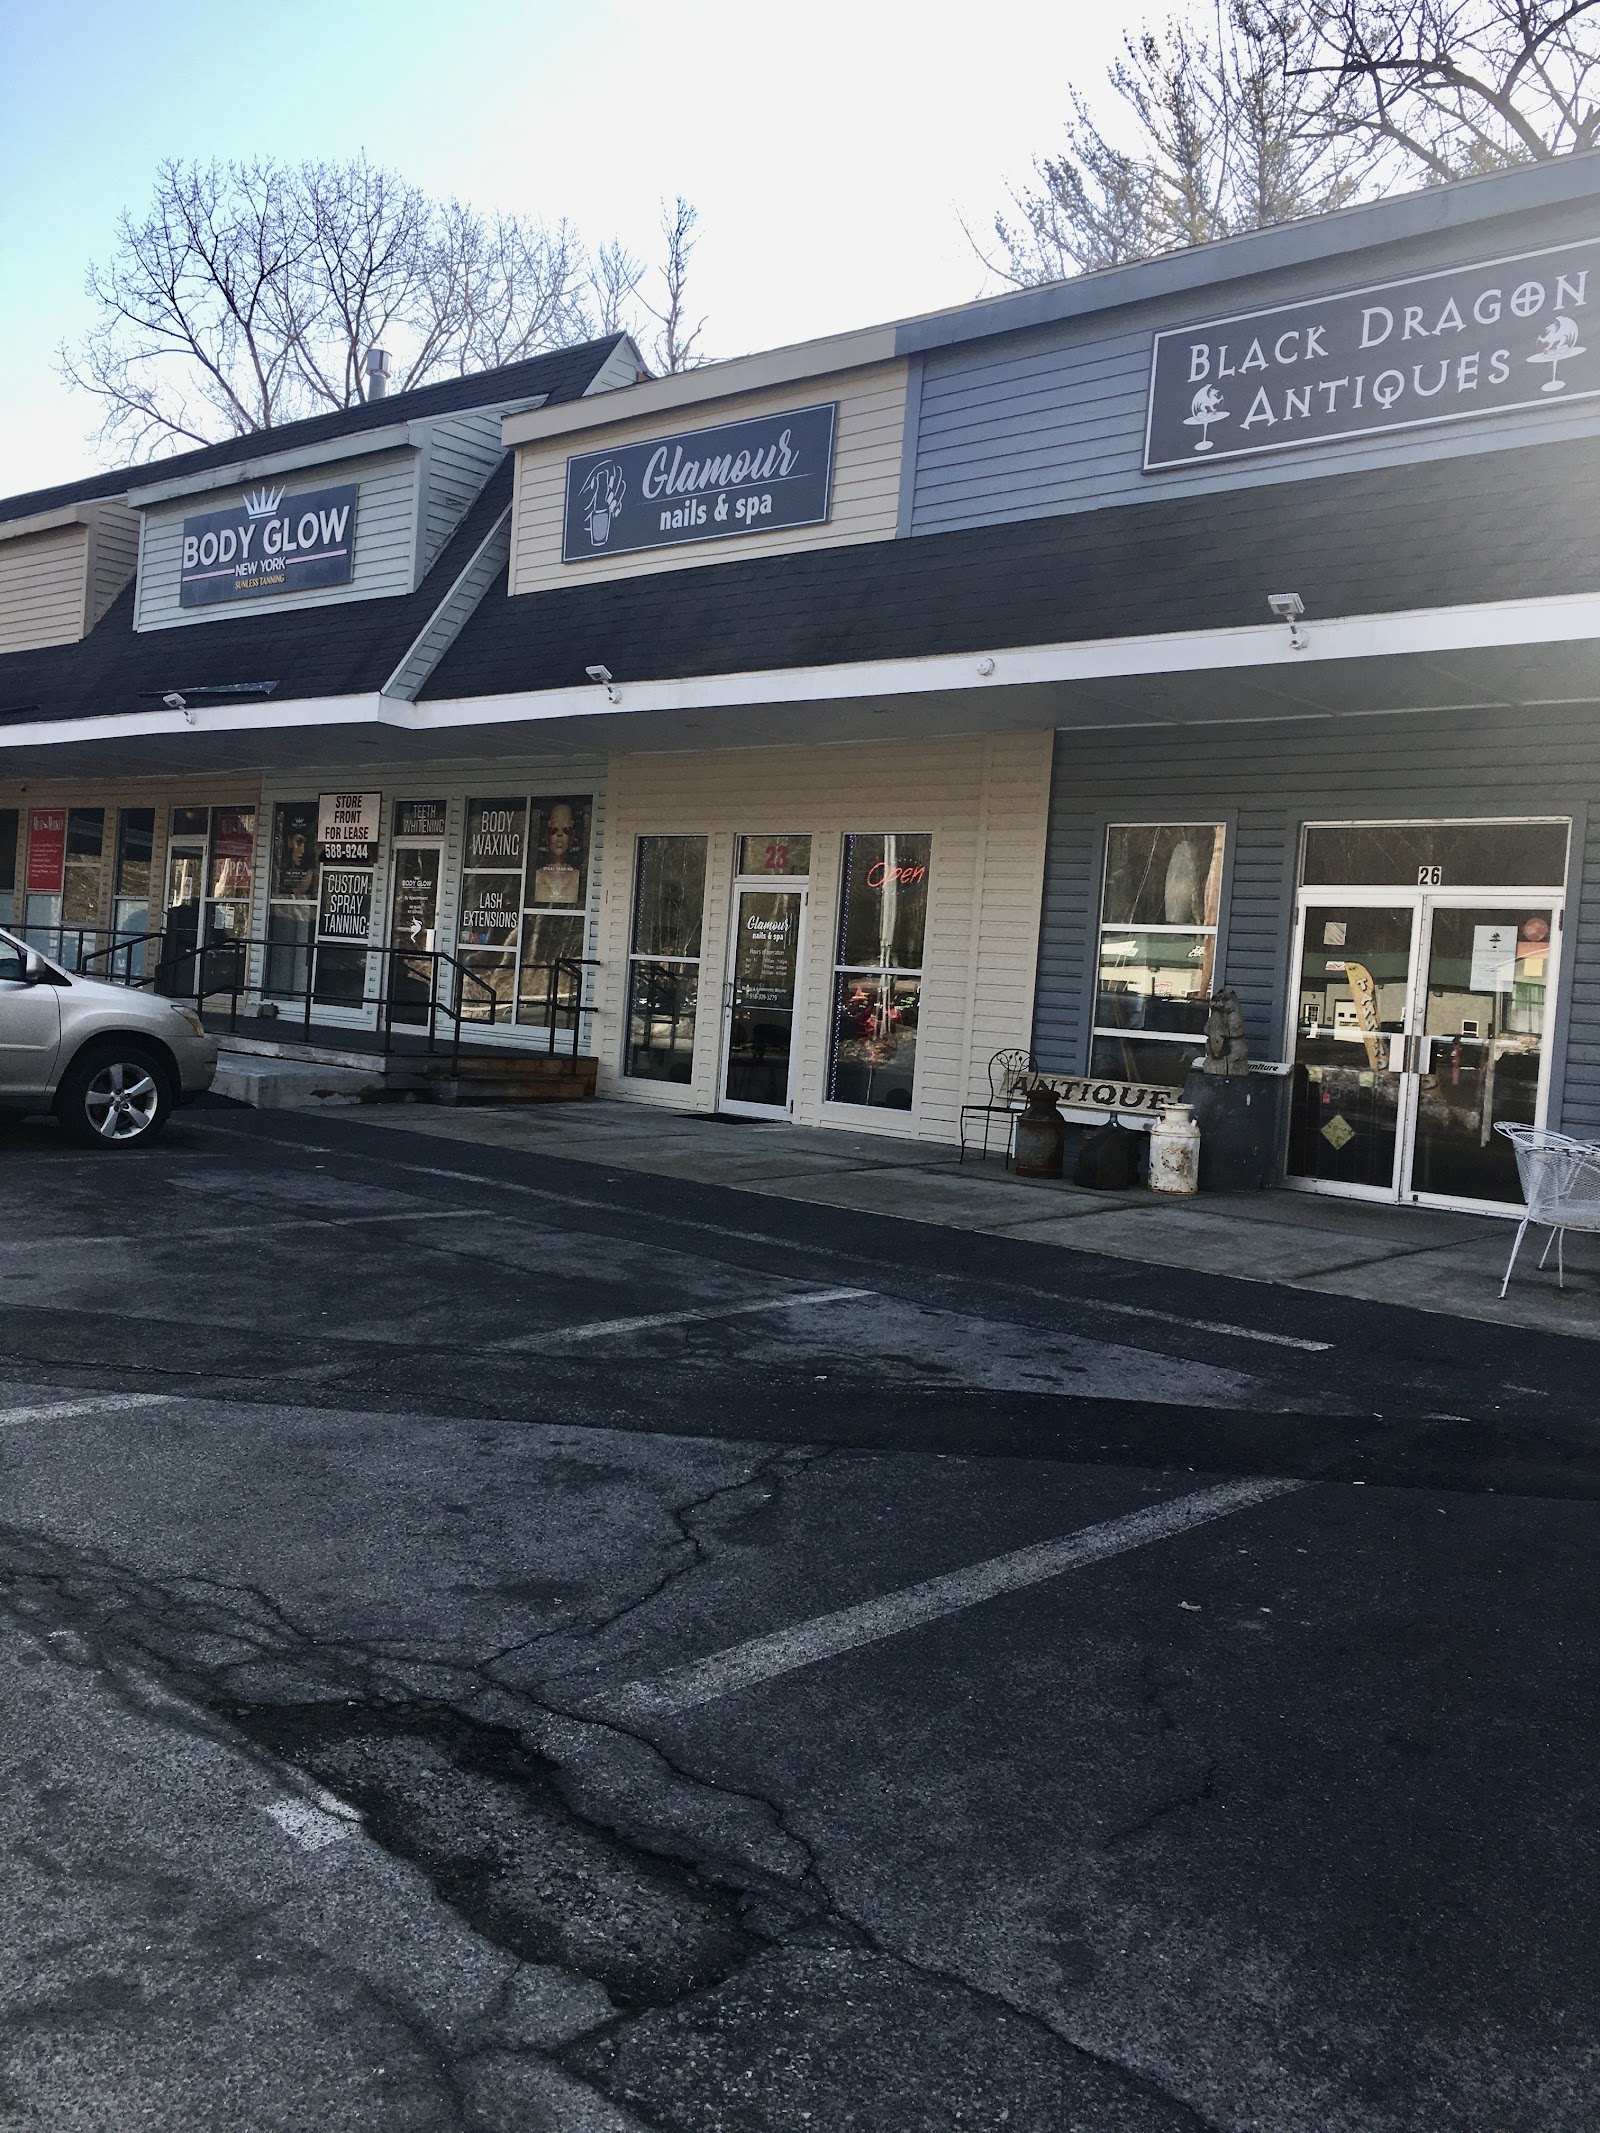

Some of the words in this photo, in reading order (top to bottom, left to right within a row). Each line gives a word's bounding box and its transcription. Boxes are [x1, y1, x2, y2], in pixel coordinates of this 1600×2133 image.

[1187, 325, 1329, 383] BLACK
[1359, 270, 1589, 349] DRAGON
[1240, 350, 1510, 430] ANTIQUES
[642, 428, 800, 499] Glamour
[659, 499, 707, 530] nails
[713, 494, 729, 522] &
[735, 494, 773, 524] spa
[183, 524, 256, 569] BODY
[263, 505, 350, 555] GLOW
[235, 562, 258, 577] NEW
[260, 556, 287, 573] YORK
[234, 578, 260, 590] SUNLESS
[259, 574, 285, 586] TANNING
[335, 795, 362, 808] STORE
[413, 804, 437, 818] TEETH
[334, 811, 362, 823] FRONT
[403, 819, 444, 832] WHITENING
[481, 811, 514, 832] BODY
[325, 827, 341, 839] FOR
[344, 827, 369, 839] LEASE
[325, 844, 368, 858] 588-9244
[472, 834, 520, 855] WAXING
[764, 845, 787, 869] 23
[328, 874, 369, 894] CUSTOM
[867, 862, 926, 888] Open
[1419, 867, 1441, 885] 26
[330, 894, 364, 914] SPRAY
[480, 892, 503, 909] LASH
[324, 913, 366, 935] TANNING
[463, 910, 518, 928] EXTENSIONS
[747, 915, 790, 931] Glamour
[752, 932, 766, 940] nails
[767, 932, 773, 940] &
[773, 933, 784, 942] spa
[1008, 1076, 1183, 1110] ANTIQUE
